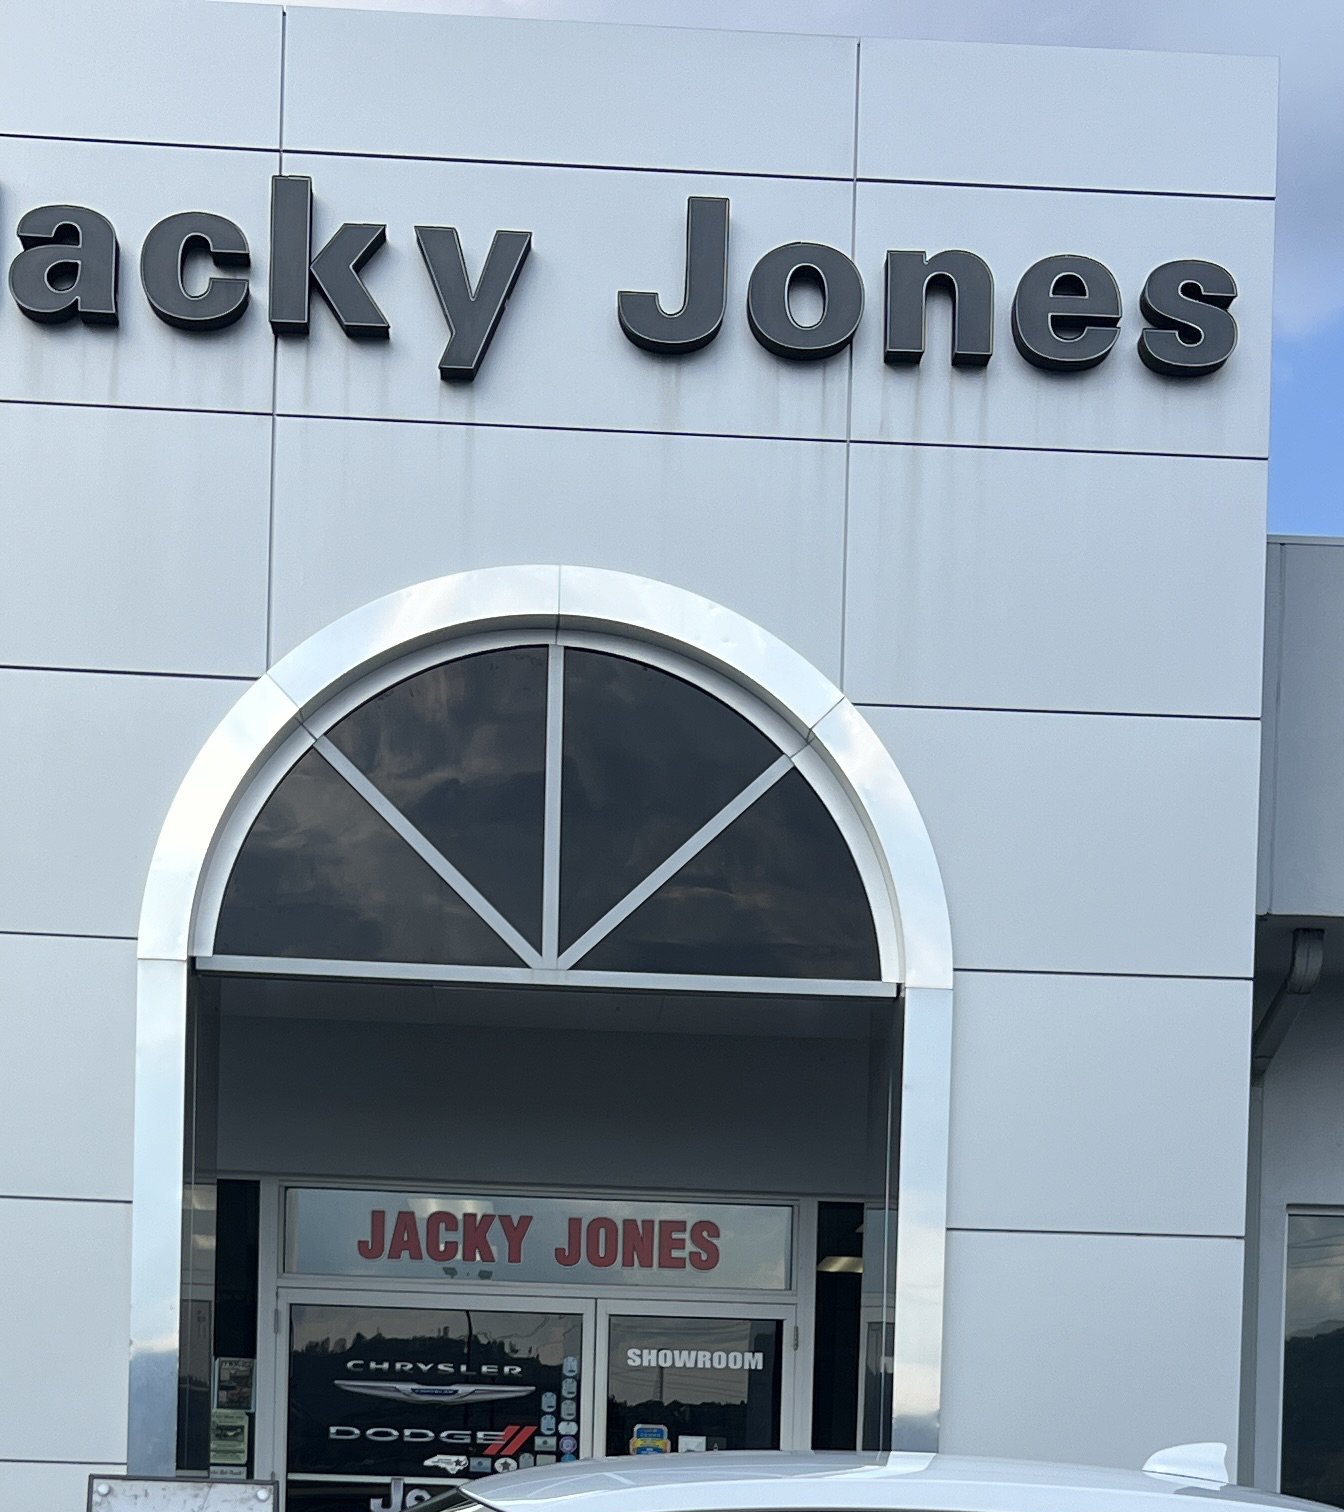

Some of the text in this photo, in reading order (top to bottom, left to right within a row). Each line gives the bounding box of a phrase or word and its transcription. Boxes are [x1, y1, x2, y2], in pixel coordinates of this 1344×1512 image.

[616, 195, 1242, 379] Jones
[358, 1209, 721, 1271] JACKY JONES
[346, 1359, 523, 1377] CHRYSLER
[626, 1348, 764, 1371] SHOWROOM
[329, 1425, 507, 1445] DODGE
